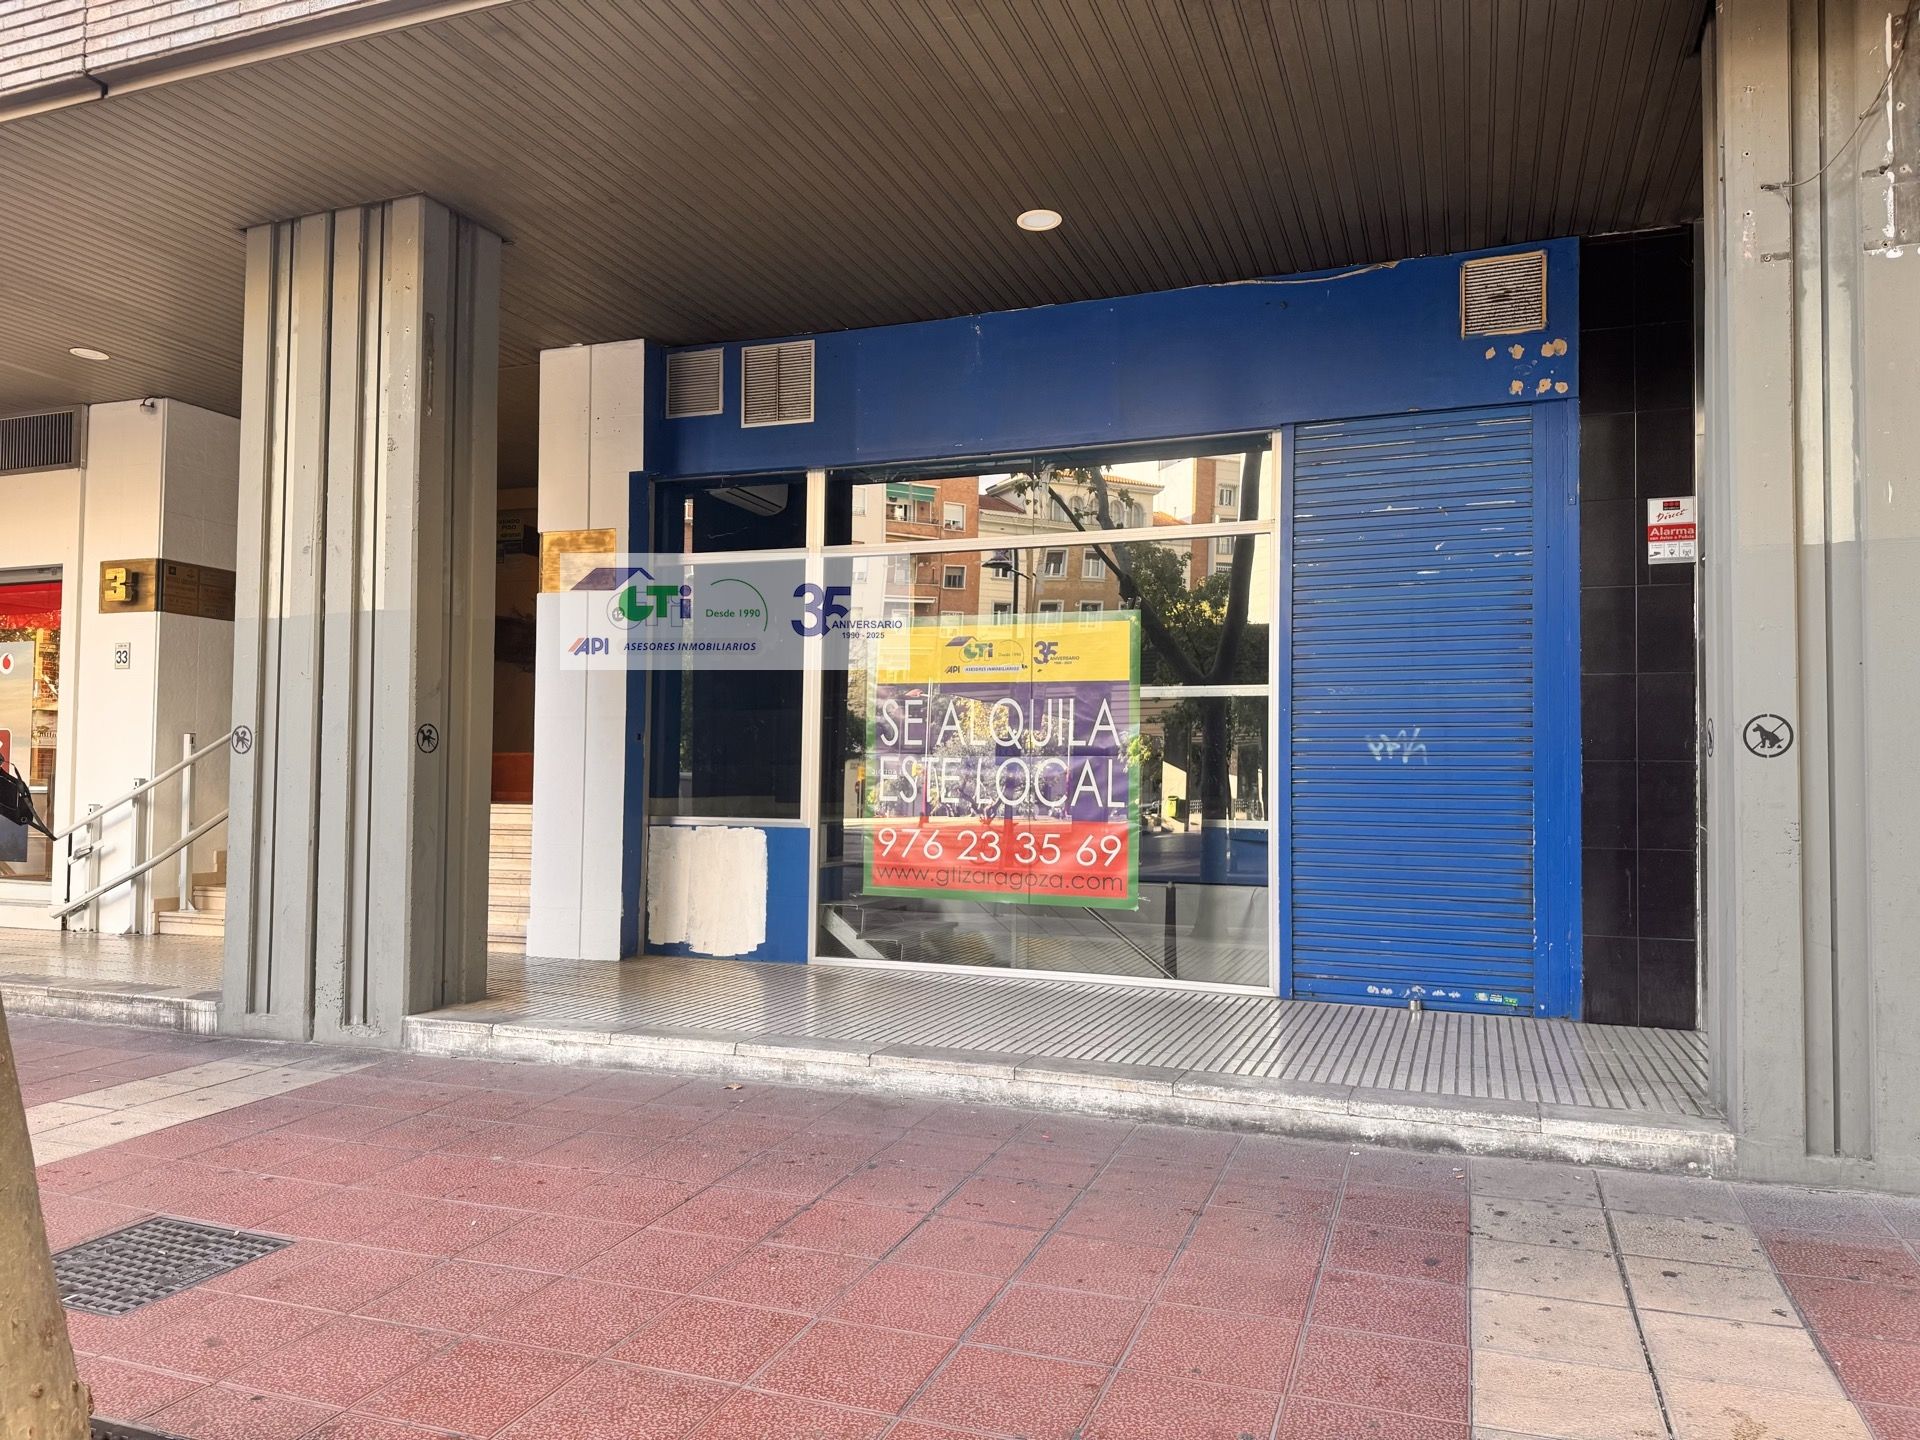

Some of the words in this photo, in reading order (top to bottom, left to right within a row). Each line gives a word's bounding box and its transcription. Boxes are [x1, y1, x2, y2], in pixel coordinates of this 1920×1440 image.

[1650, 527, 1695, 536] Alarma
[104, 567, 128, 602] 3
[116, 650, 128, 664] 33
[880, 698, 923, 747] SE
[937, 697, 1121, 754] ALQUILA
[879, 755, 960, 803] ESTE
[976, 758, 1126, 809] LOCAL
[878, 828, 944, 861] 976
[957, 830, 1001, 863] 23
[1015, 832, 1061, 865] 35
[1076, 835, 1122, 868] 69
[875, 863, 1124, 892] www.gtizaragoza.com
